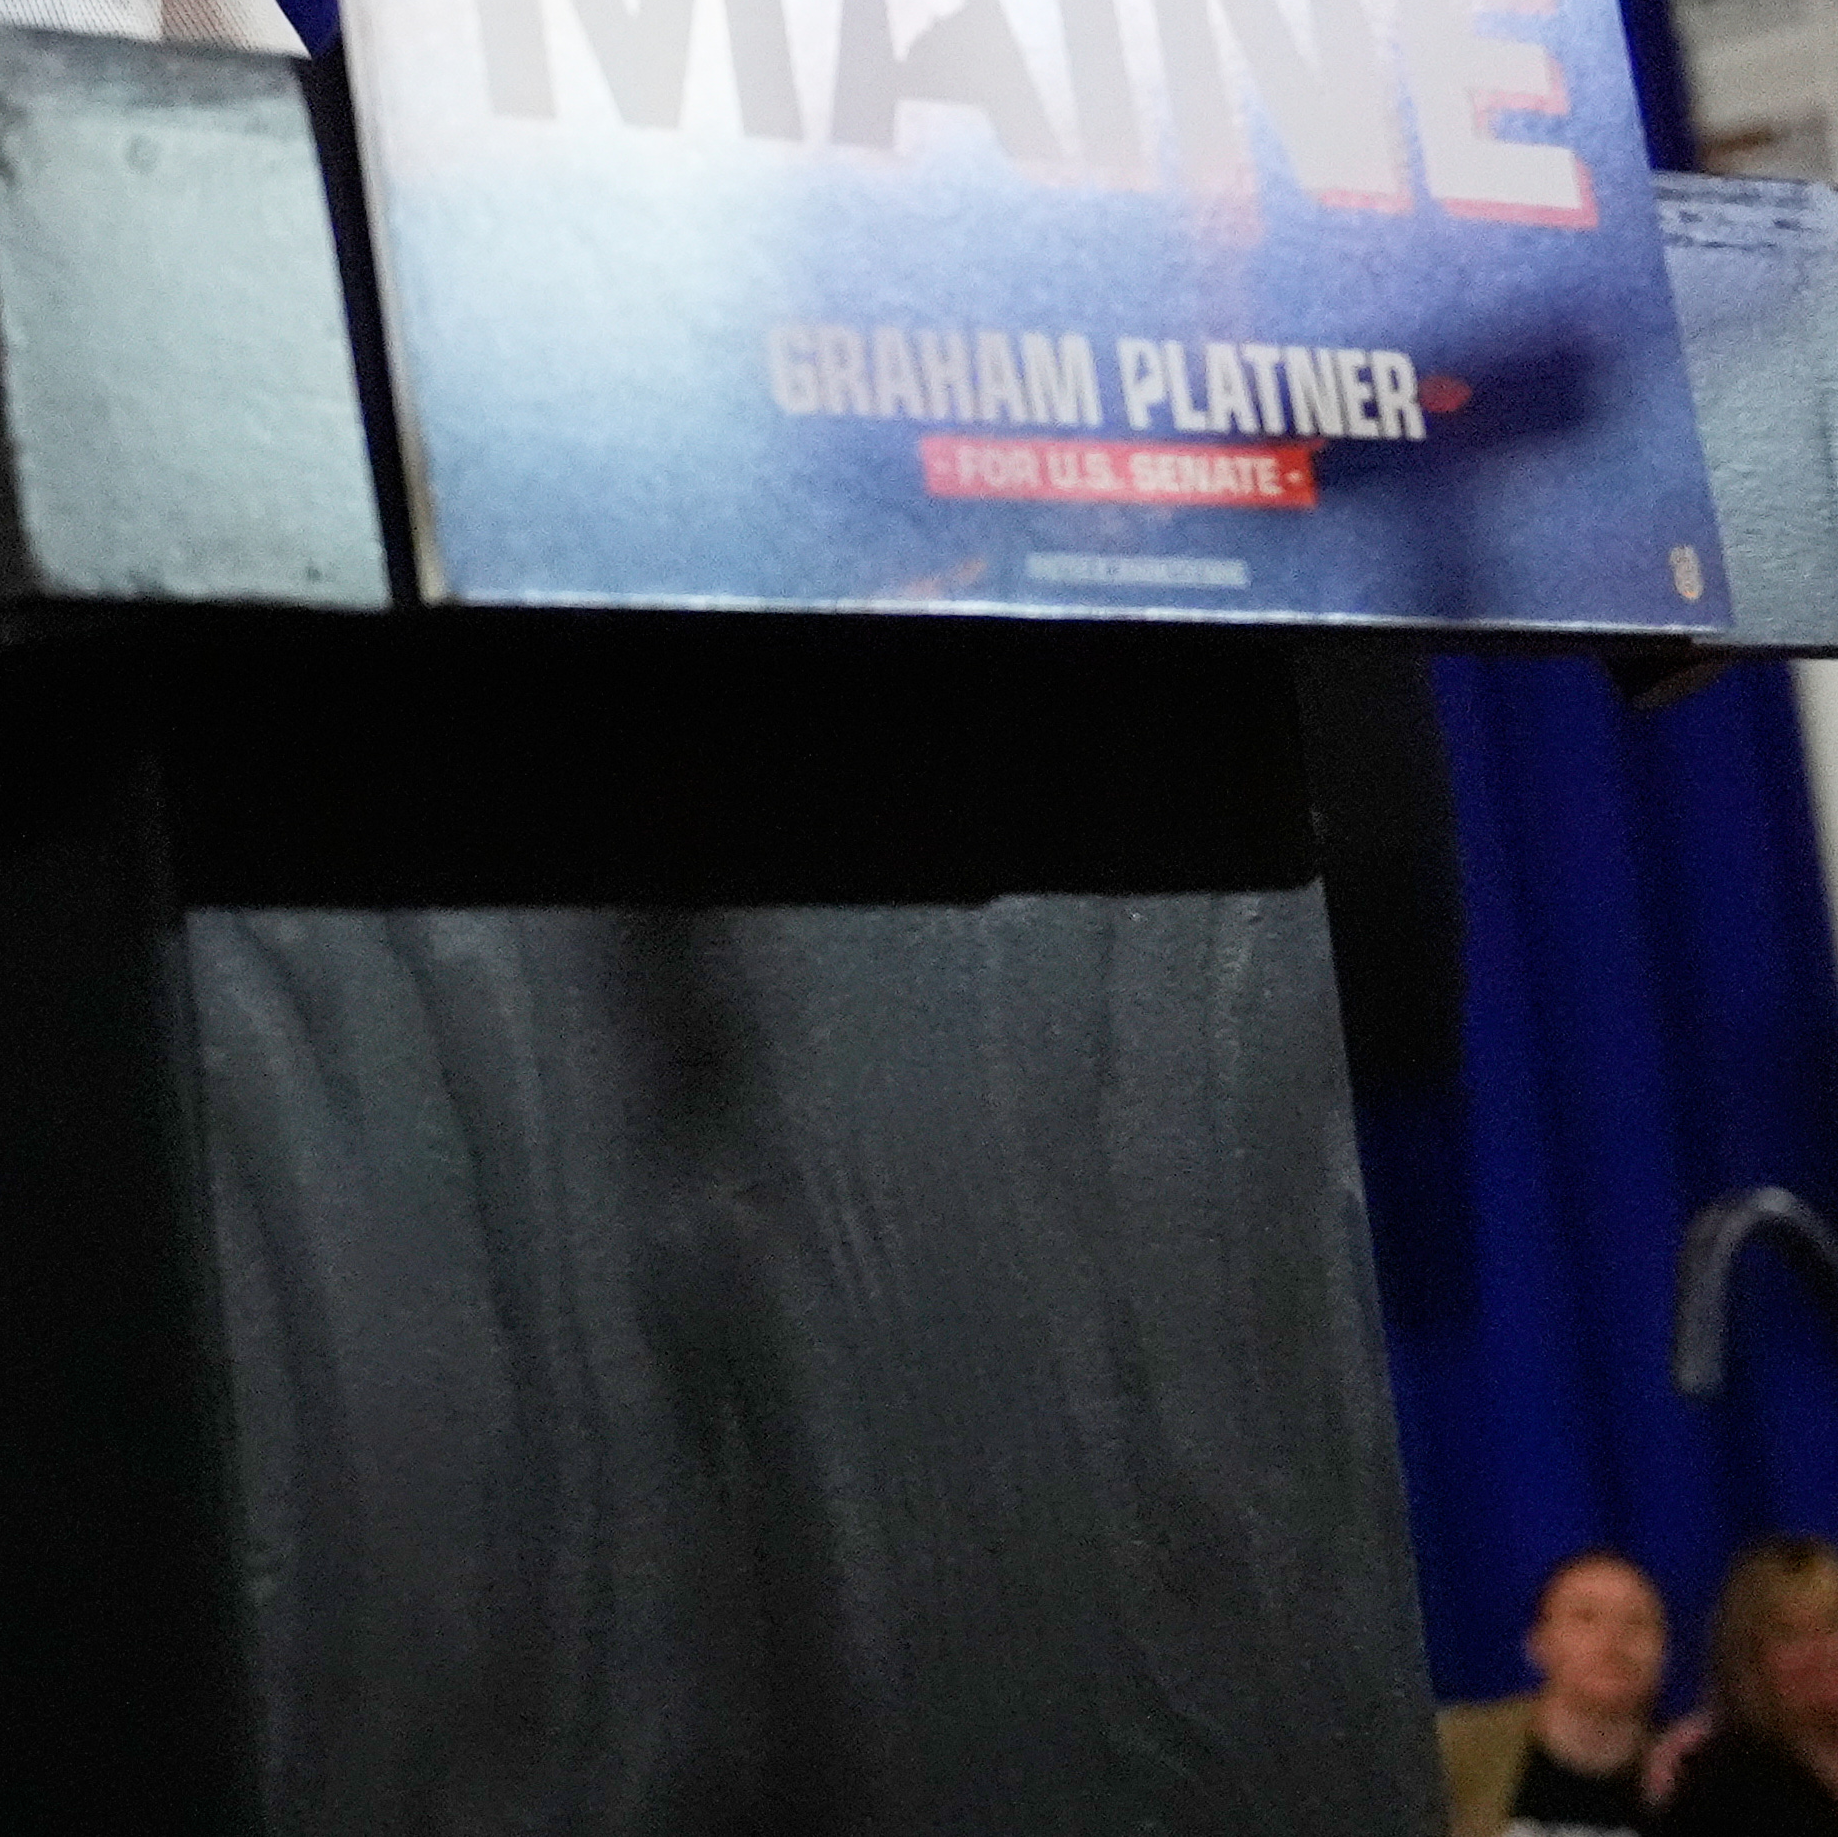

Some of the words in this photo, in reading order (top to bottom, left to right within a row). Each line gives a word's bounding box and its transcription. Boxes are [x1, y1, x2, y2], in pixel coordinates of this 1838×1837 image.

[768, 322, 1103, 428] GRAHAM
[1119, 335, 1427, 441] PLATNER
[953, 448, 1035, 489] FOR
[1047, 450, 1119, 492] U.S.
[1130, 453, 1282, 497] SENATE
